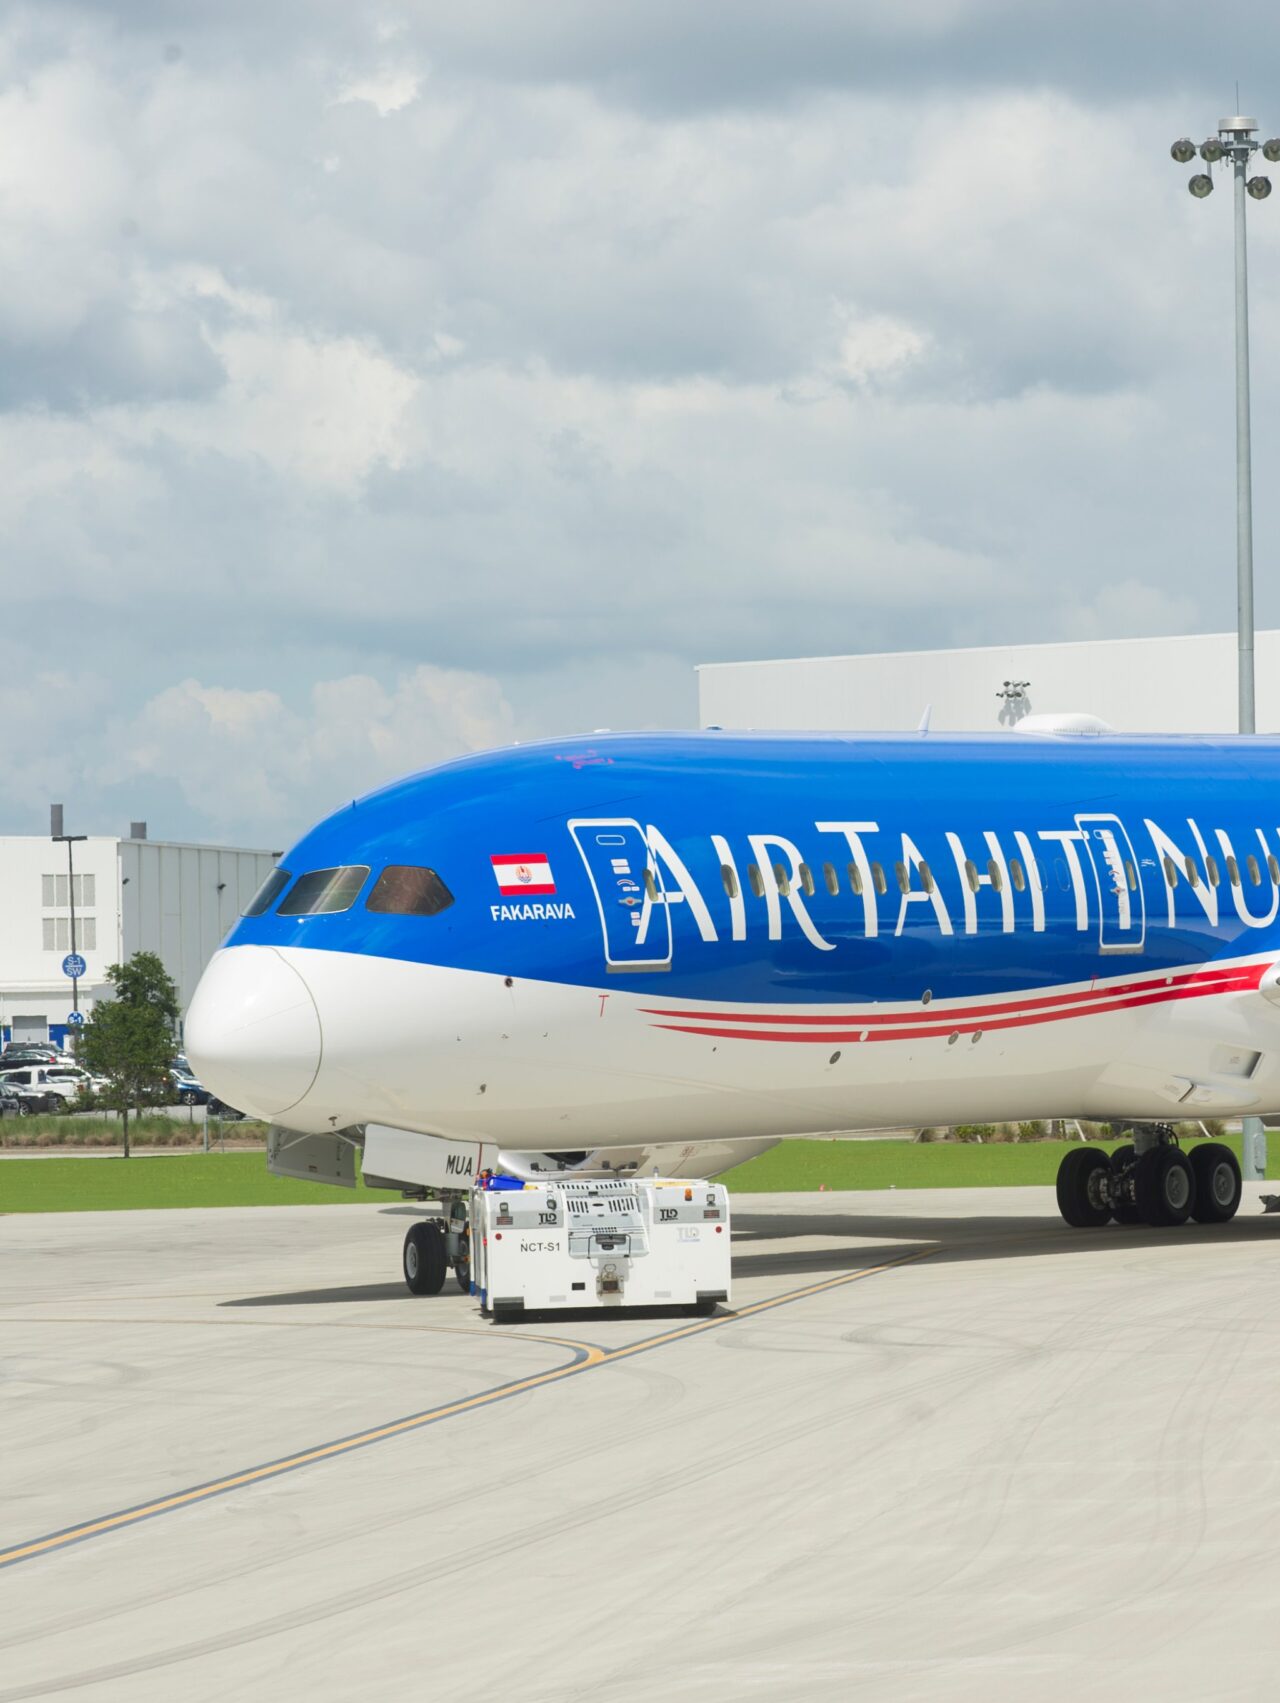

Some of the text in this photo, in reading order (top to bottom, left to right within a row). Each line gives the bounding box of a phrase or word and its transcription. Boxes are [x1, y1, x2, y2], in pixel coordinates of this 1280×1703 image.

[490, 903, 576, 922] FAKARAVA
[67, 957, 81, 965] S-1
[66, 967, 82, 975] SW
[68, 1016, 82, 1024] S-1
[446, 1154, 473, 1176] MUA
[538, 1212, 557, 1224] TLD
[520, 1241, 560, 1252] NCT-S1
